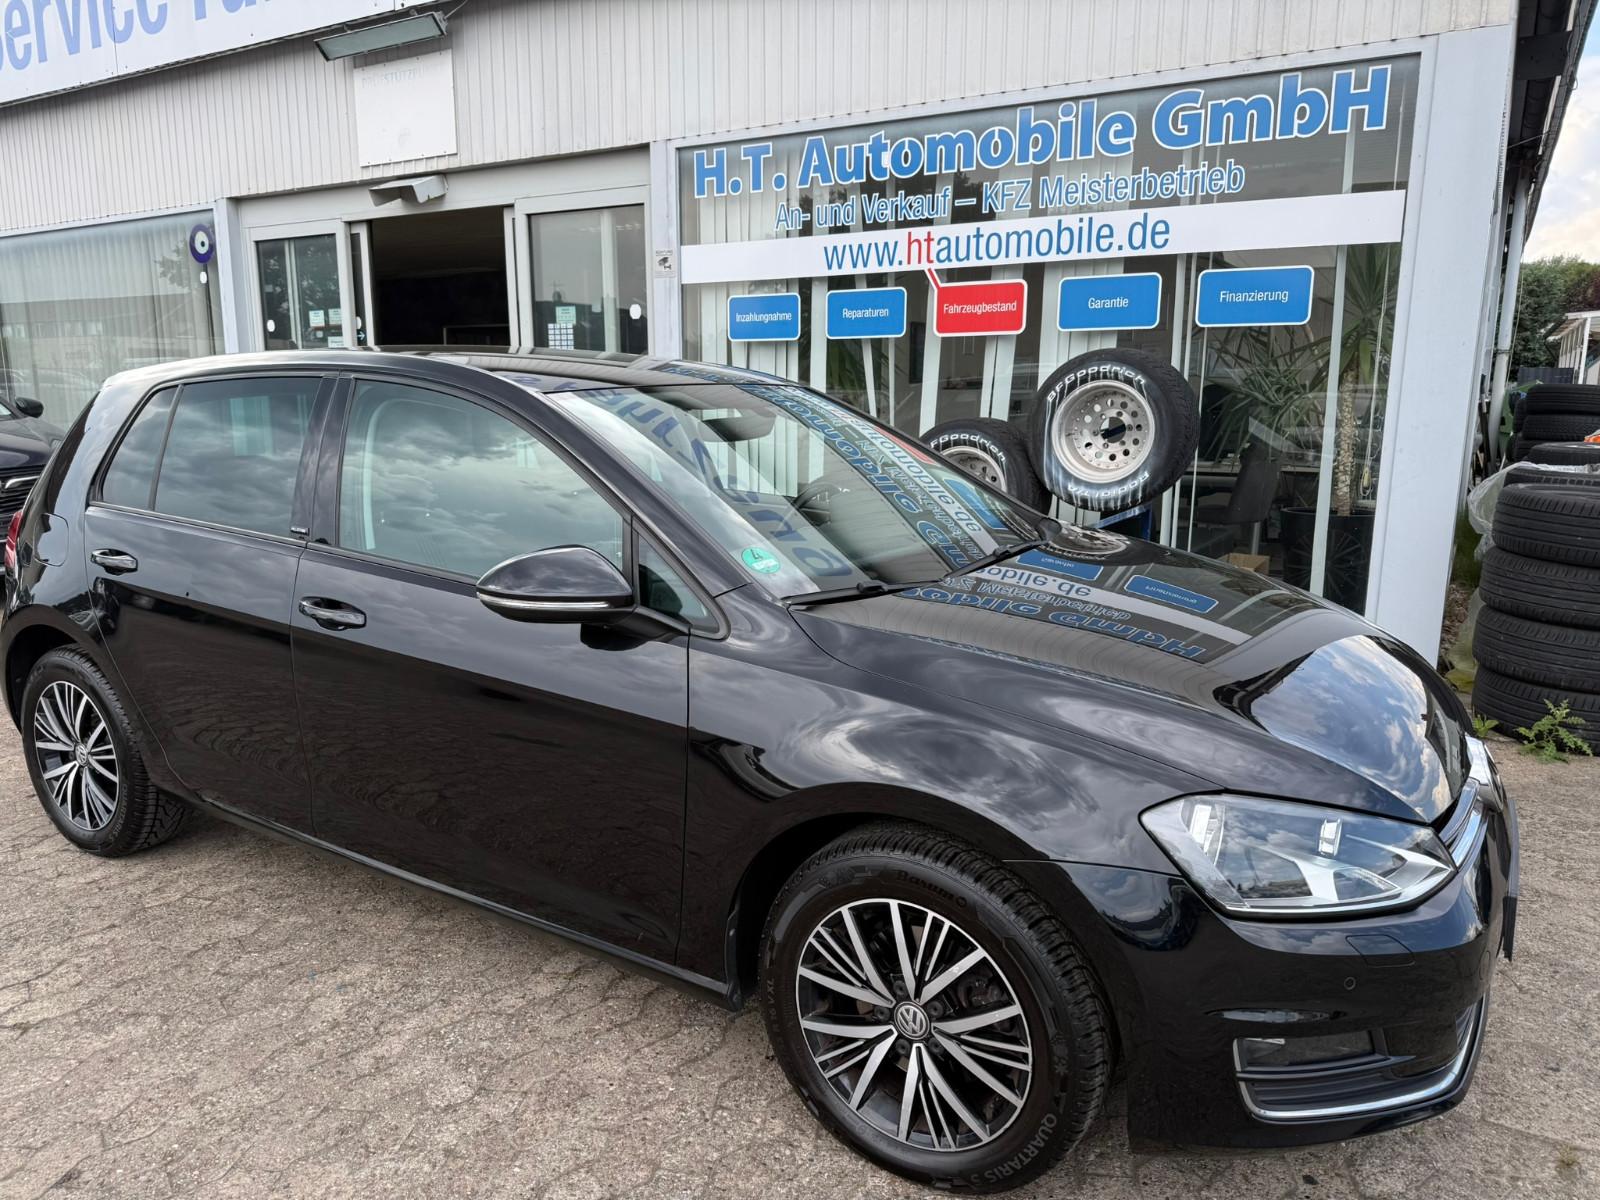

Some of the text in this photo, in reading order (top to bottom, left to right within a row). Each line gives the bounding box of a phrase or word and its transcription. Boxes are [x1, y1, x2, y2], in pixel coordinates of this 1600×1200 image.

[0, 0, 168, 72] ervice
[693, 64, 1392, 198] H.T. Automobile GmbH
[775, 203, 810, 232] An-
[816, 196, 856, 228] und
[862, 186, 951, 223] Verkauf
[982, 177, 1032, 214] KFZ
[1039, 158, 1245, 209] Meisterbetrieb
[824, 212, 1170, 271] www.htautomobile.de
[943, 300, 1017, 315] Fahrzeugbestand
[1087, 296, 1129, 309] Garantie
[1219, 289, 1289, 303] Finanzierung
[736, 311, 792, 323] Inzahlungnahme
[842, 307, 889, 320] Reparaturen
[1047, 364, 1146, 401] BFGoodrich
[930, 433, 1006, 461] FGoodrich
[983, 1113, 1057, 1183] QUARTARIS
